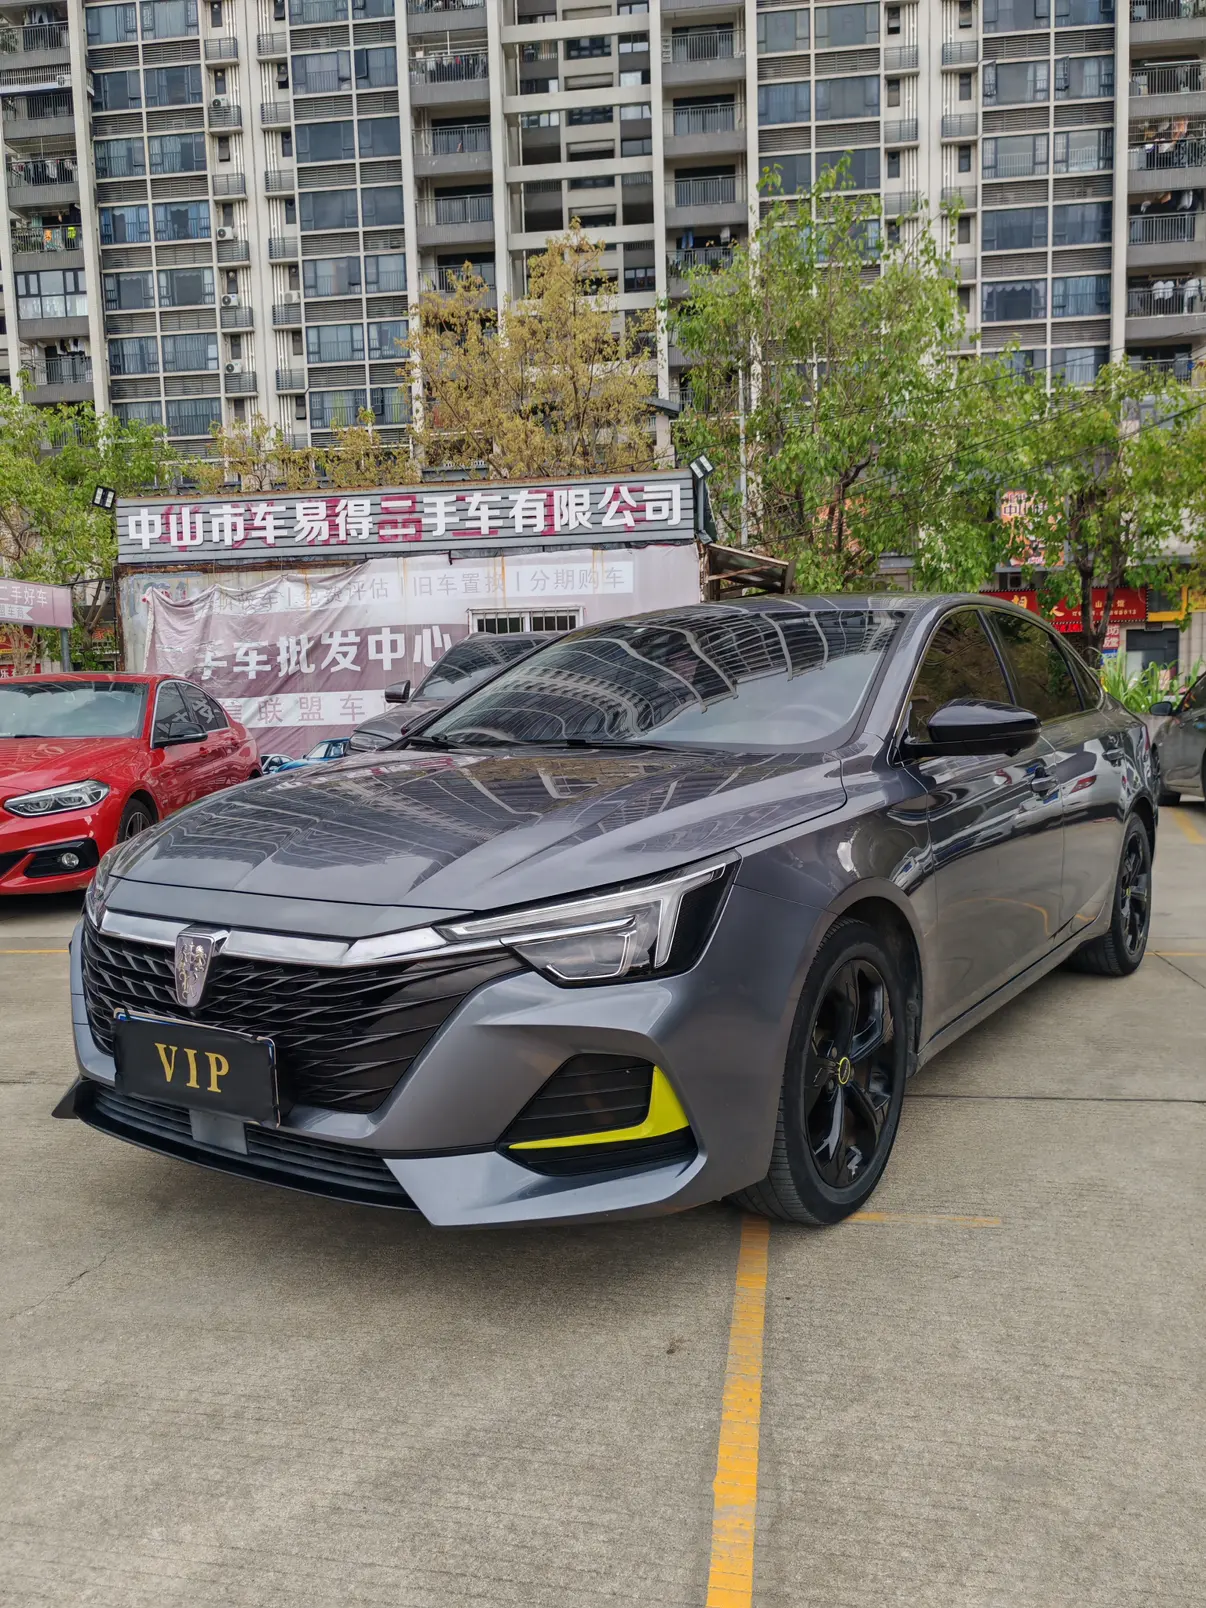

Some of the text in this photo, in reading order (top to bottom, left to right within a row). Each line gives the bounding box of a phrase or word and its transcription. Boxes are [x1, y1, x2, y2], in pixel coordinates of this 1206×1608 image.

[128, 484, 681, 550] 中山市车易得二手车有限公司
[529, 567, 626, 592] 分期购车
[154, 1042, 230, 1093] VIP
